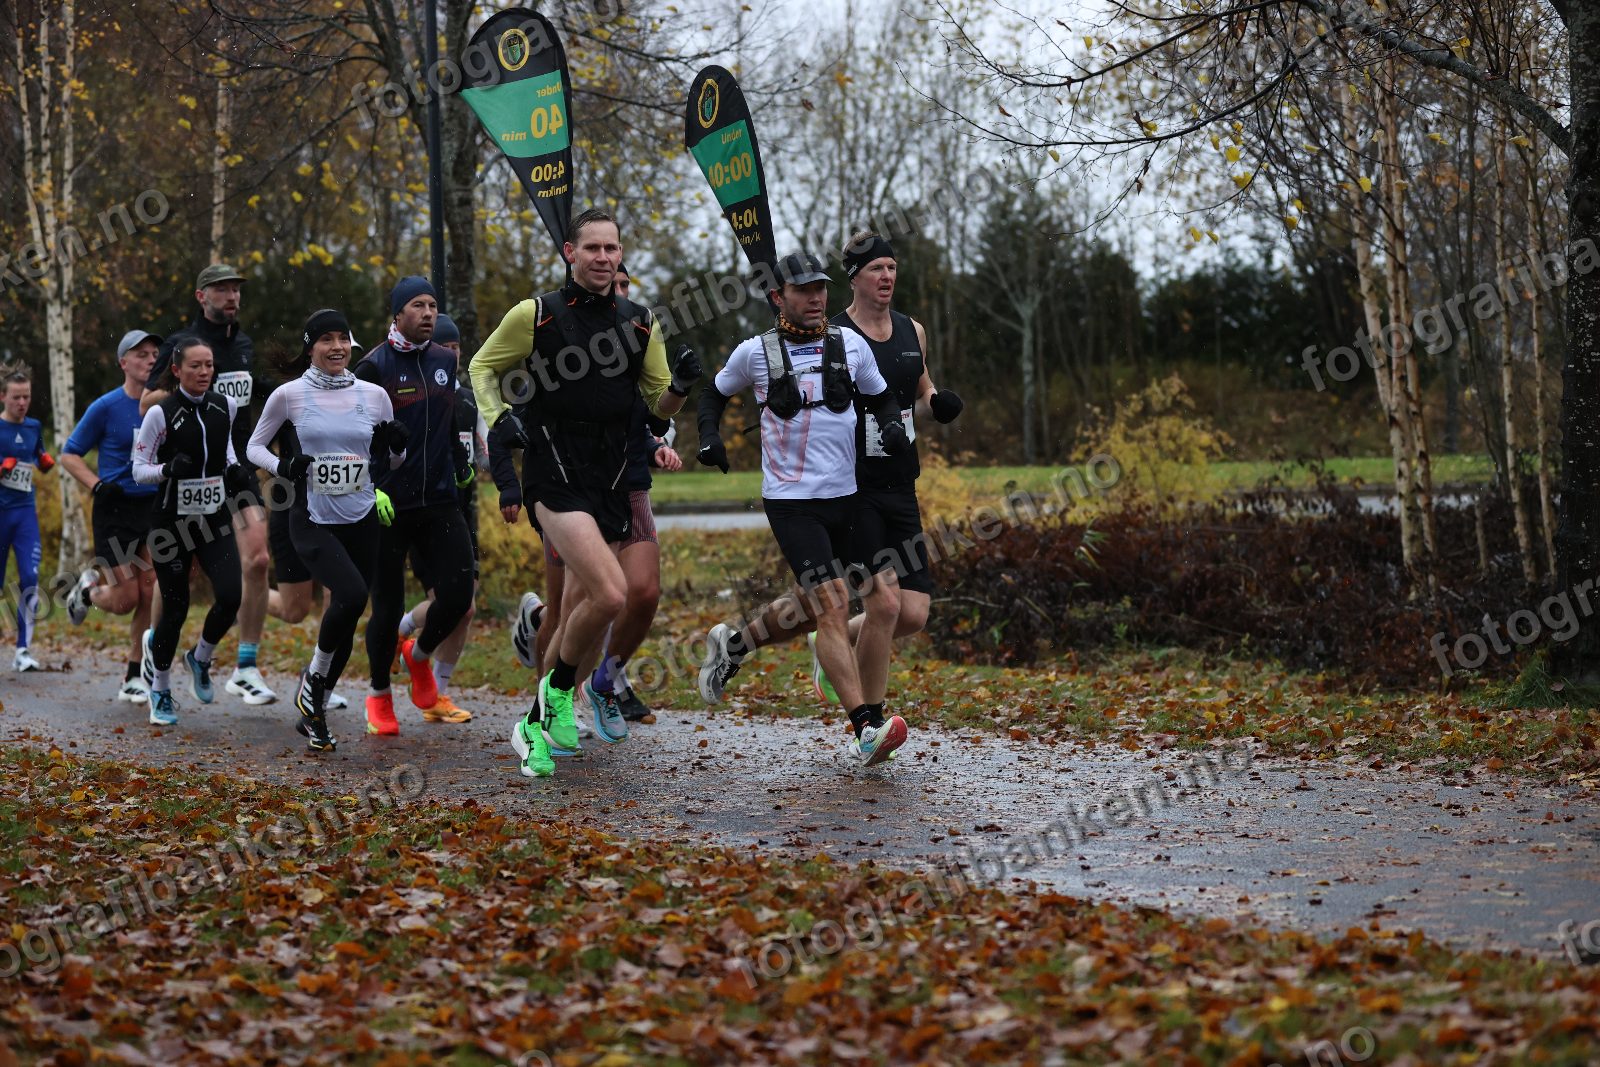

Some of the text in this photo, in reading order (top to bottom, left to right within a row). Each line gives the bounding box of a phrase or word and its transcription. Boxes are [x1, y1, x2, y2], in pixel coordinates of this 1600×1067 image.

[721, 128, 743, 145] Under
[218, 379, 249, 398] 9002
[317, 463, 364, 485] 9517
[182, 486, 221, 506] 9495
